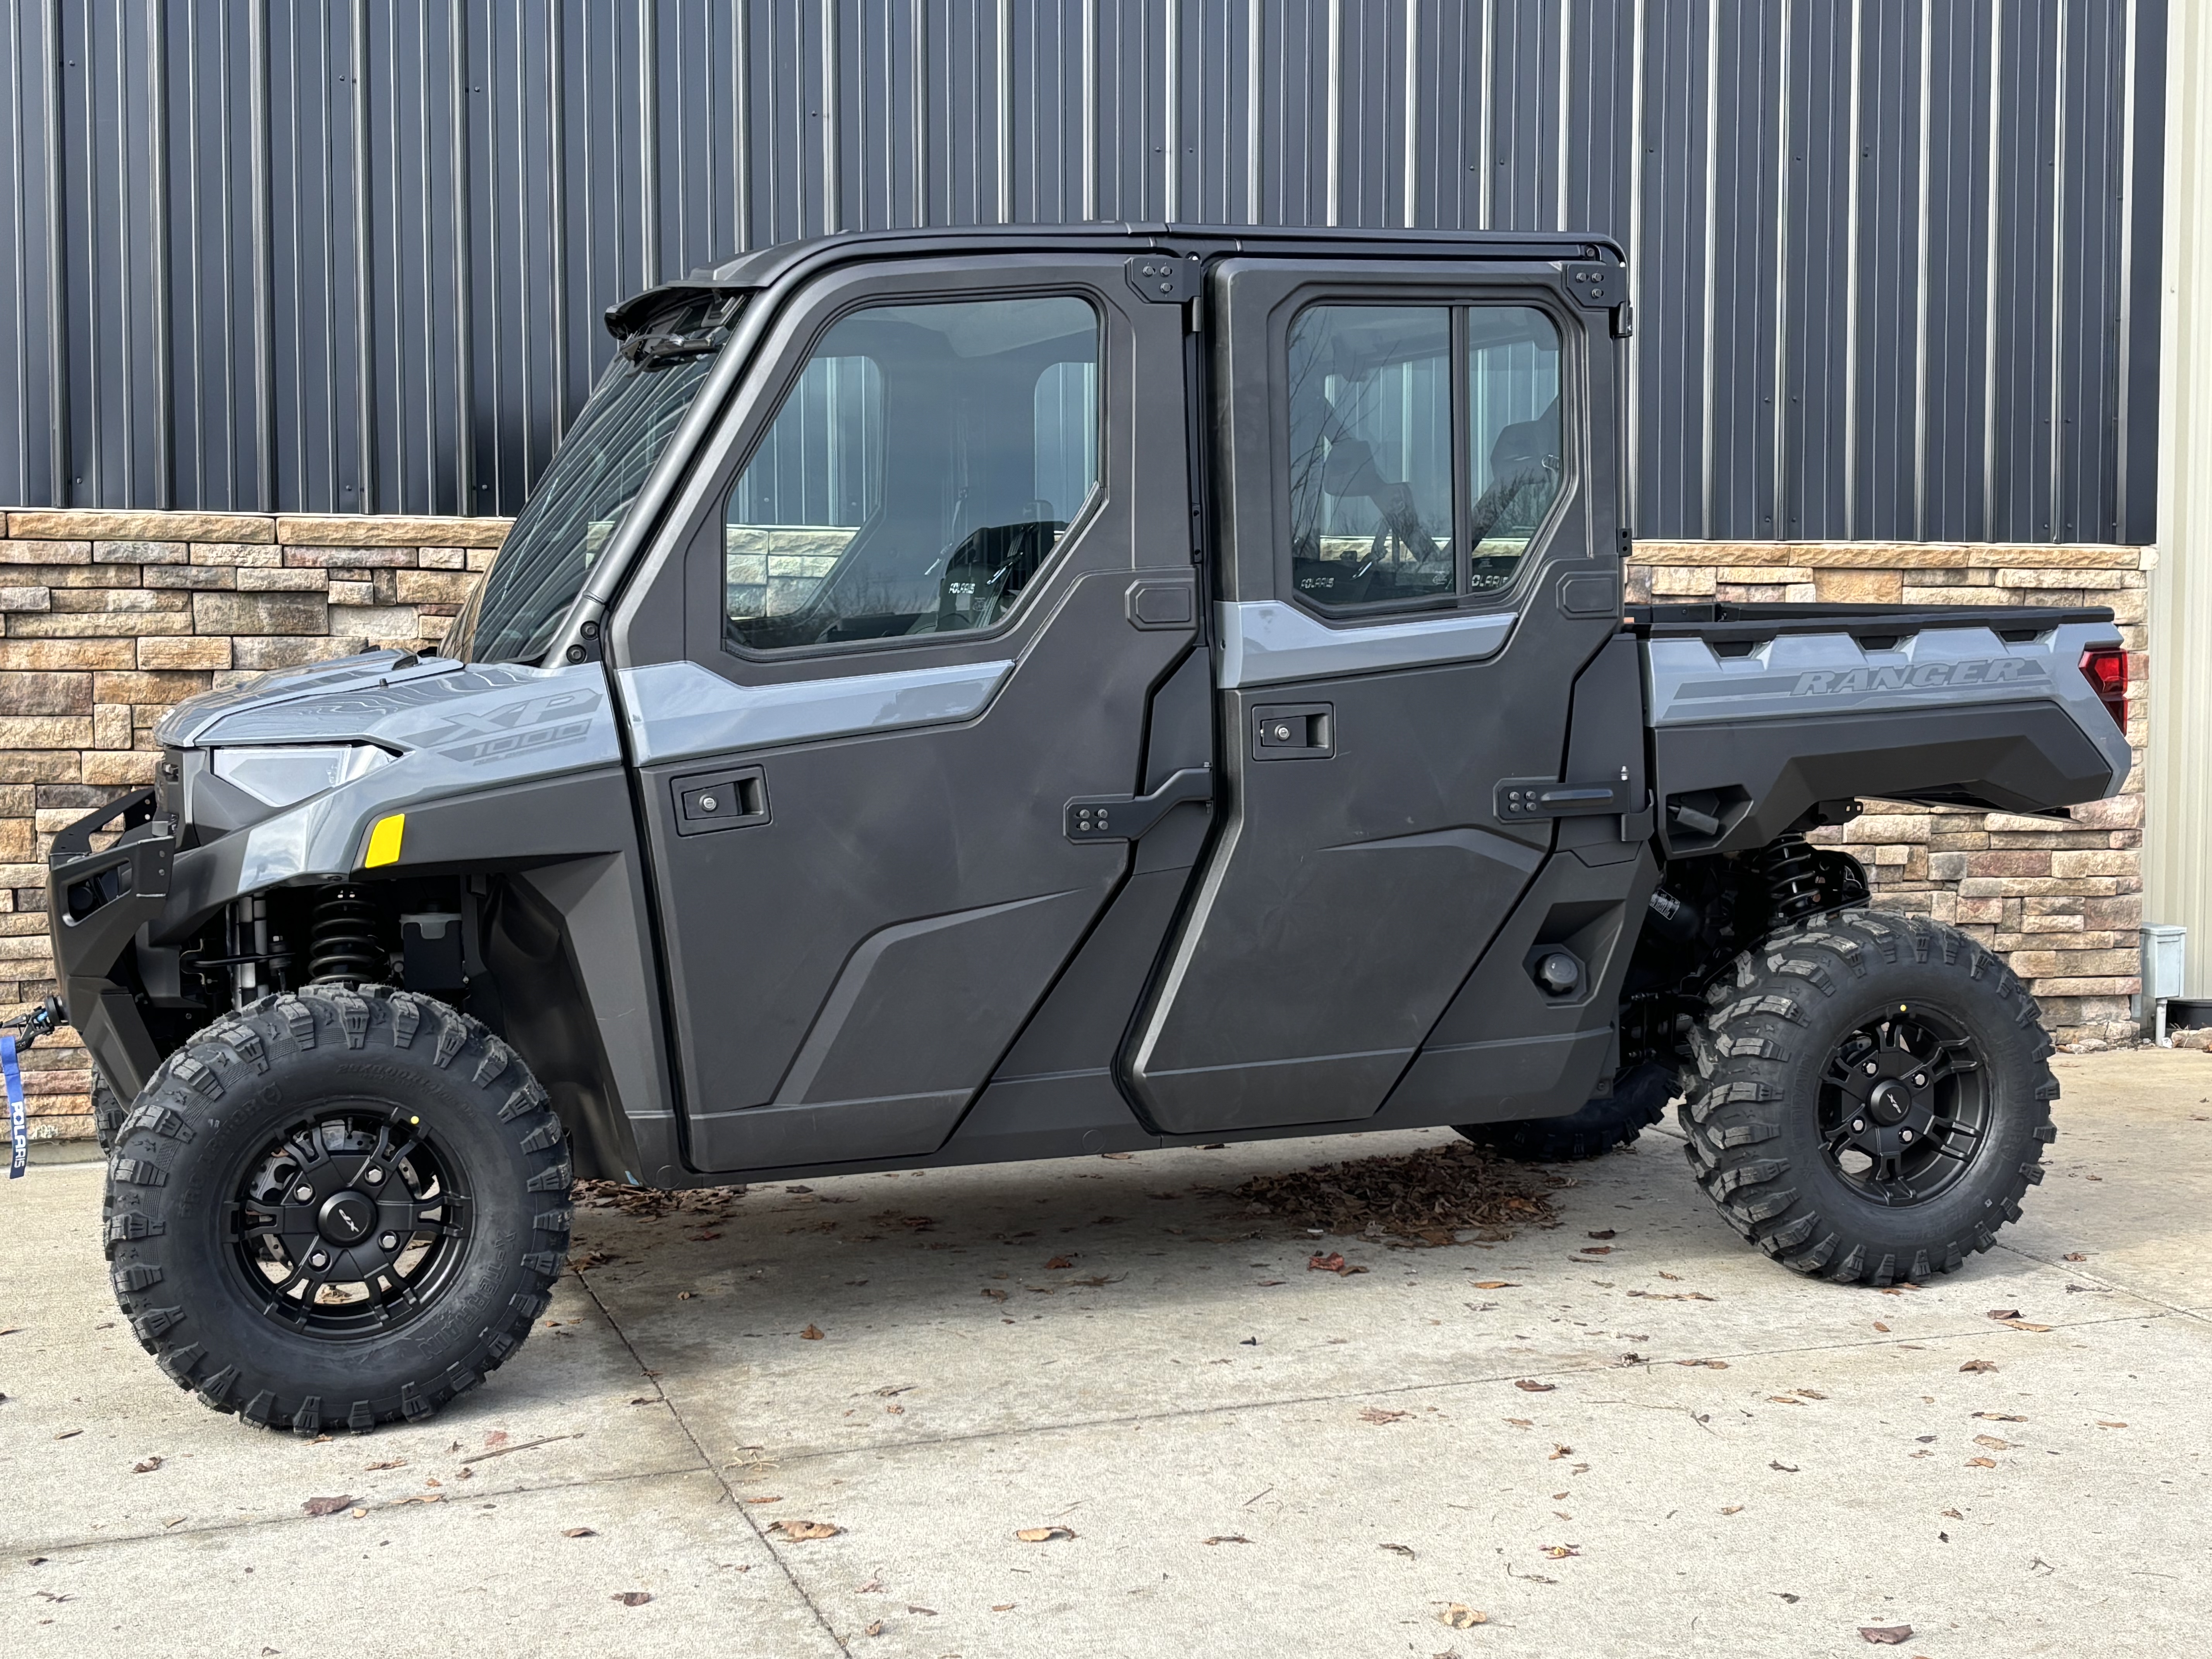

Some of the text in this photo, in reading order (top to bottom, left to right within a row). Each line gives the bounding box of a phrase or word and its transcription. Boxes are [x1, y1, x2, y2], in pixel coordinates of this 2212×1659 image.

[1300, 577, 1334, 589] POLARIS
[1472, 574, 1509, 588] OLARI
[1788, 656, 2027, 697] RANGER
[426, 687, 599, 748] XP
[473, 719, 592, 757] 1000
[11, 1101, 26, 1168] POLARIS
[338, 1209, 359, 1232] XP
